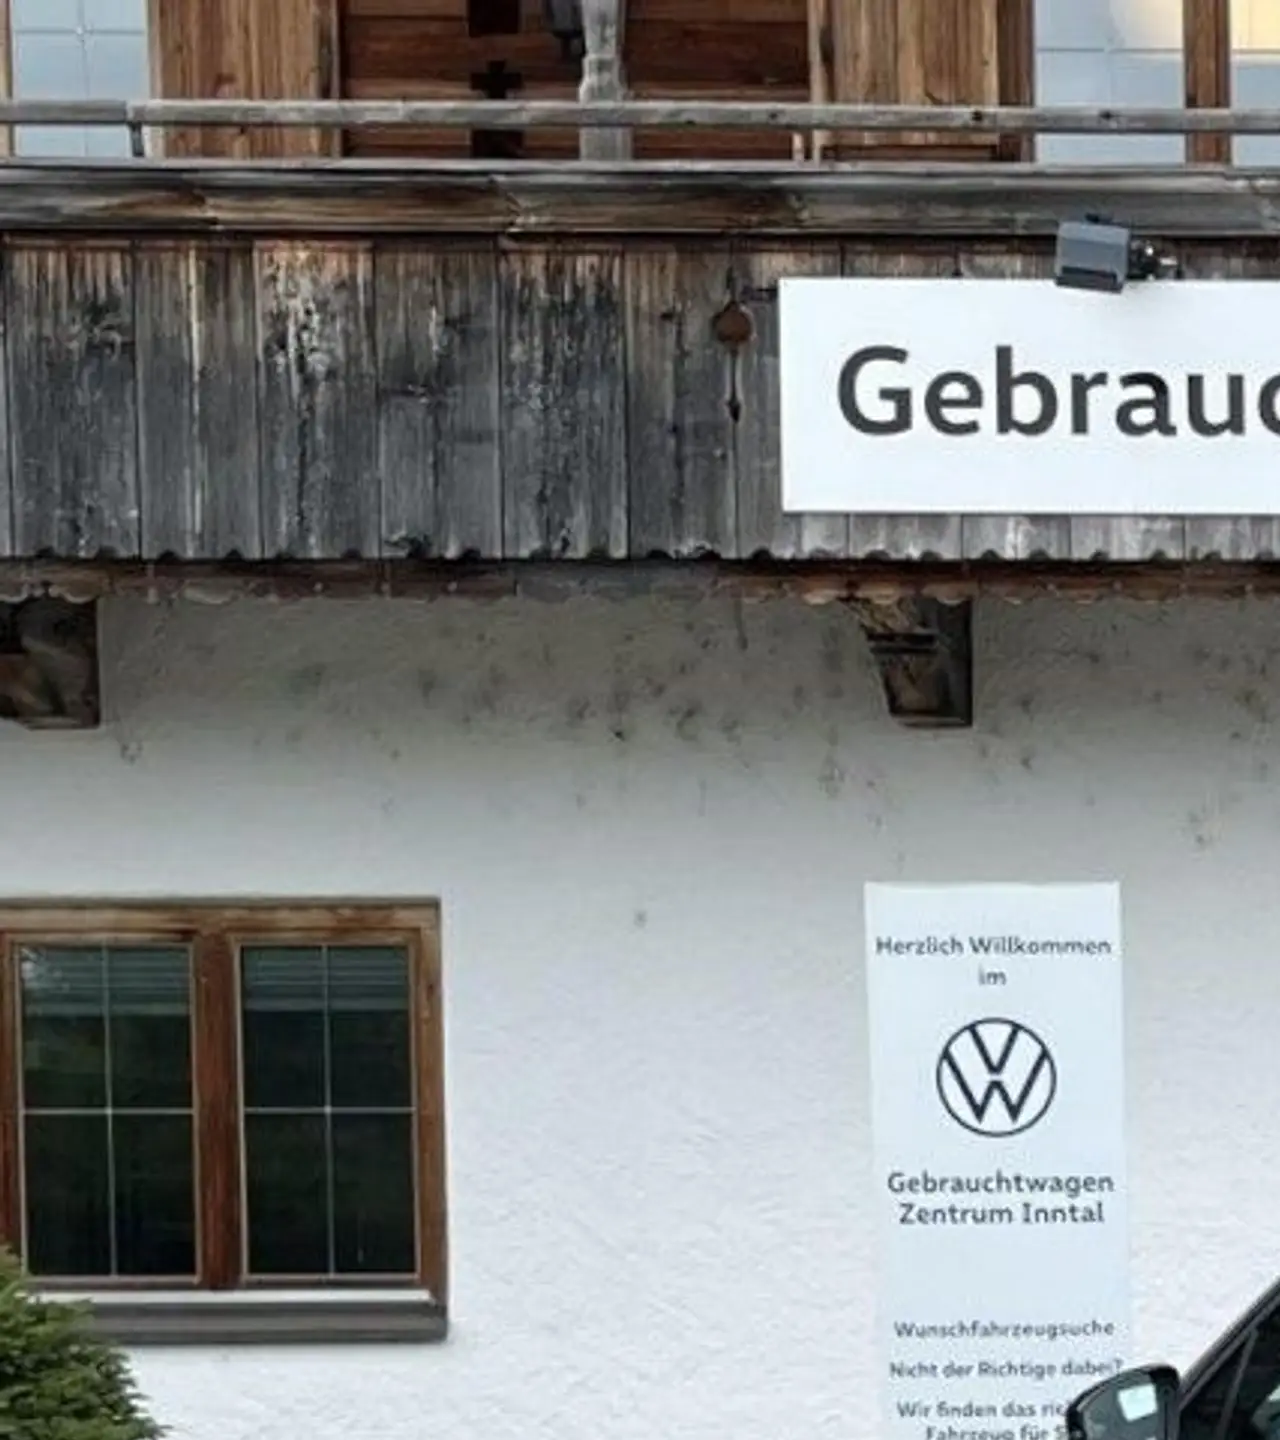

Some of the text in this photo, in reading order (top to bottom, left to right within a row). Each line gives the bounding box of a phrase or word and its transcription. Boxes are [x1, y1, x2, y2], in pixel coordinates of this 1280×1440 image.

[875, 935, 1112, 956] Herzlich Willkommen
[978, 966, 1007, 986] im
[887, 1169, 1115, 1202] Gebrauchtwagen
[898, 1201, 1105, 1225] Zentrum Inntal
[893, 1319, 1115, 1341] Wunschfahrzeugsuche
[889, 1361, 938, 1379] Nicht
[942, 1360, 974, 1379] der
[977, 1360, 1056, 1381] Richtige
[896, 1401, 931, 1418] Wir
[936, 1400, 997, 1418] finden
[1001, 1401, 1036, 1418] das
